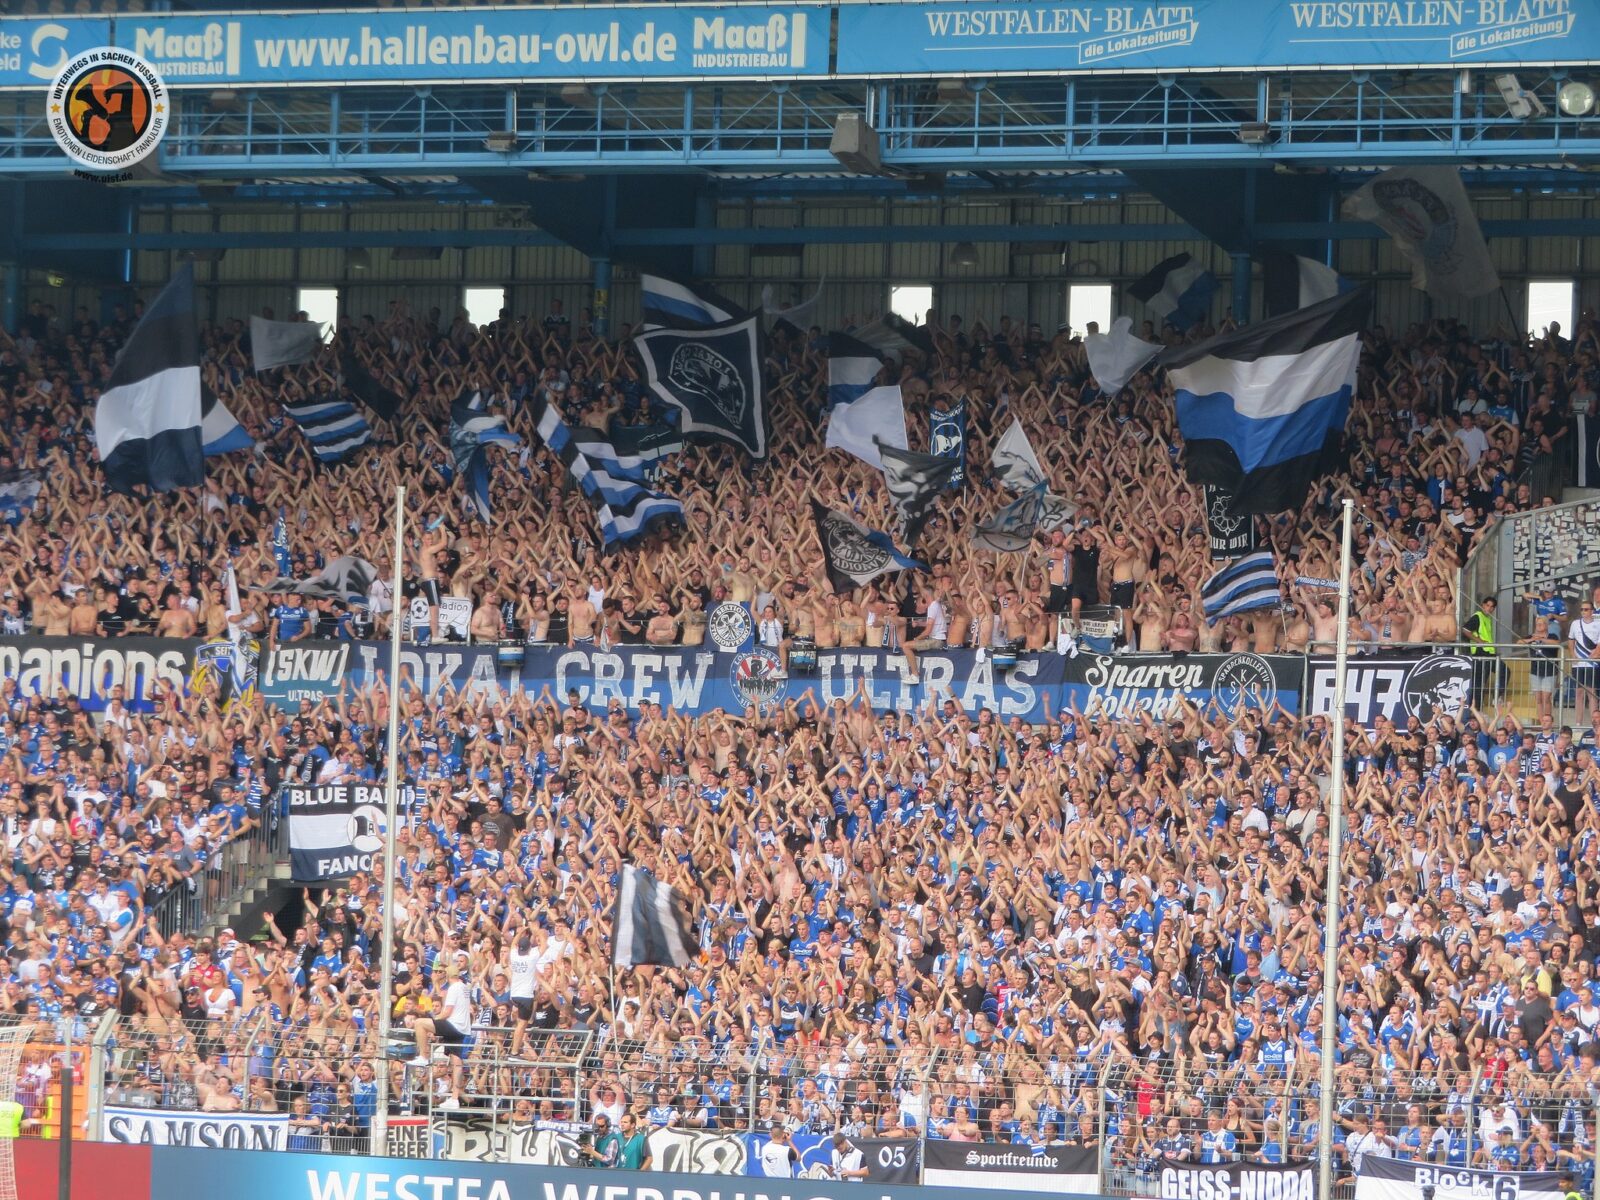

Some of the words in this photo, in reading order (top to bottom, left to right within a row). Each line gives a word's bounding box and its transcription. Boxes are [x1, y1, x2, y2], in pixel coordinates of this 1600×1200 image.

[925, 7, 1193, 36] WESTFALEN-BLATT
[1290, 0, 1569, 28] WESTFALEN-BLATT
[136, 23, 223, 60] Maaß
[255, 22, 677, 68] www.hallenbau-owl.de
[693, 14, 788, 52] Maaß
[1084, 43, 1104, 58] die
[1107, 27, 1187, 53] Lokalzeitung
[1456, 36, 1476, 50] die
[1480, 20, 1563, 46] Lokalzeitung
[157, 61, 224, 76] USTRIEBAU
[693, 53, 788, 68] INDUSTRIEBAU
[440, 601, 468, 612] tadion
[716, 603, 747, 618] SEKTION
[556, 651, 714, 710] CREW
[818, 655, 1039, 714] ULTRAS
[1085, 655, 1204, 696] Sparren
[290, 786, 348, 806] BLUE
[109, 1115, 281, 1150] SAMSON
[388, 1142, 428, 1158] EBER
[878, 1145, 906, 1168] 05
[966, 1150, 1059, 1167] Sportfreunde
[1161, 1167, 1314, 1200] GEISS-NIDDA
[1415, 1167, 1490, 1197] Block
[1493, 1175, 1519, 1200] 6
